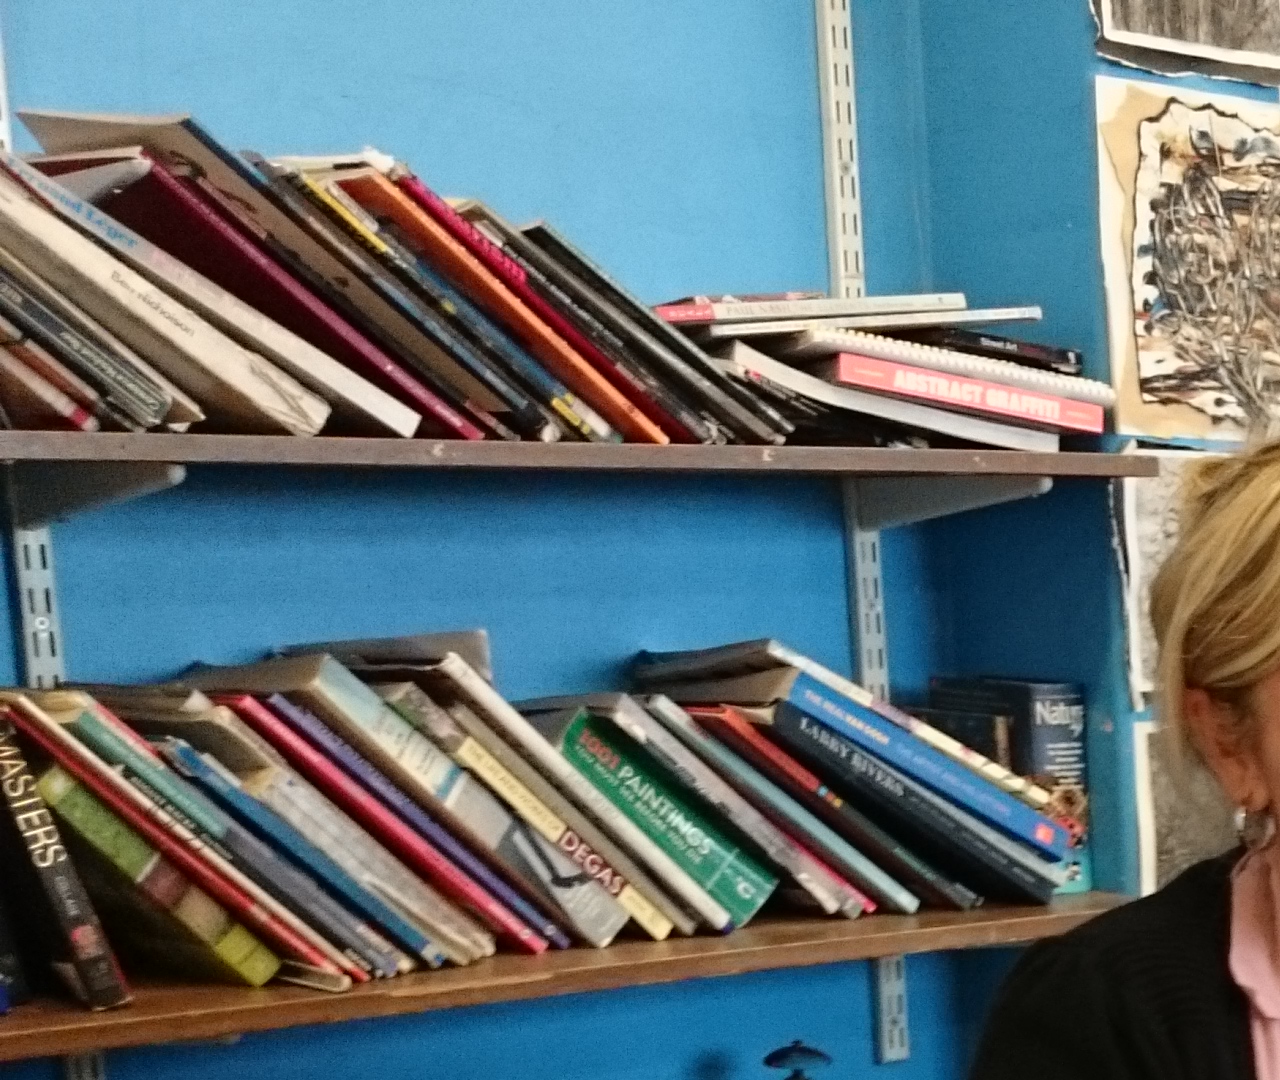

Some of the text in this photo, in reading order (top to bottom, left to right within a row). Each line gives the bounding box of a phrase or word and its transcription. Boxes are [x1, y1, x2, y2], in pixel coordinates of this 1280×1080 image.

[894, 369, 1060, 420] ABSTRACT GRAFFITI
[800, 717, 850, 759] LARRY
[618, 765, 711, 855] PAINTINGS
[559, 830, 625, 897] DEGAS
